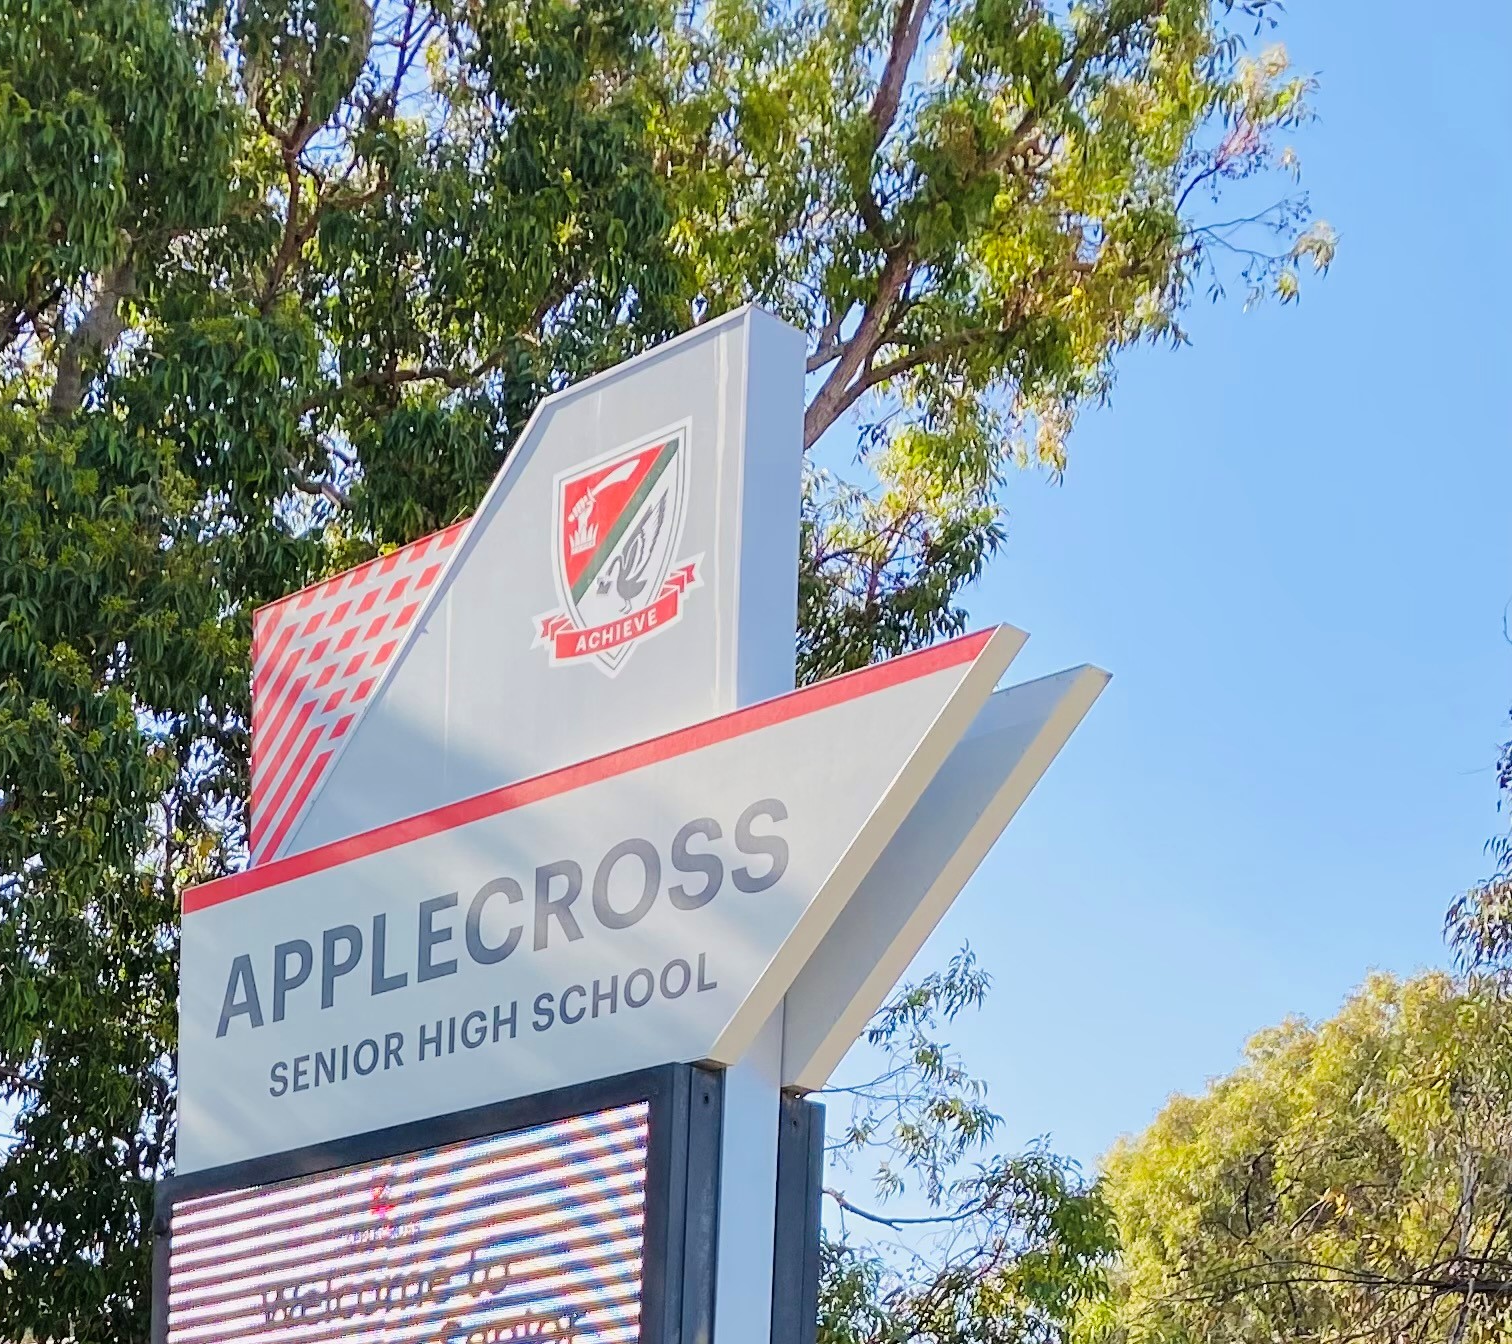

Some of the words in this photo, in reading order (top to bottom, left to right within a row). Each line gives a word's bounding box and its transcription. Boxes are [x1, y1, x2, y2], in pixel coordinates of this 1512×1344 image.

[574, 608, 658, 652] ACHIEVE
[215, 798, 789, 1038] APPLECROSS
[269, 1031, 404, 1097] SENIOR
[418, 1000, 517, 1060] HIGH
[532, 952, 718, 1031] SCHOOL
